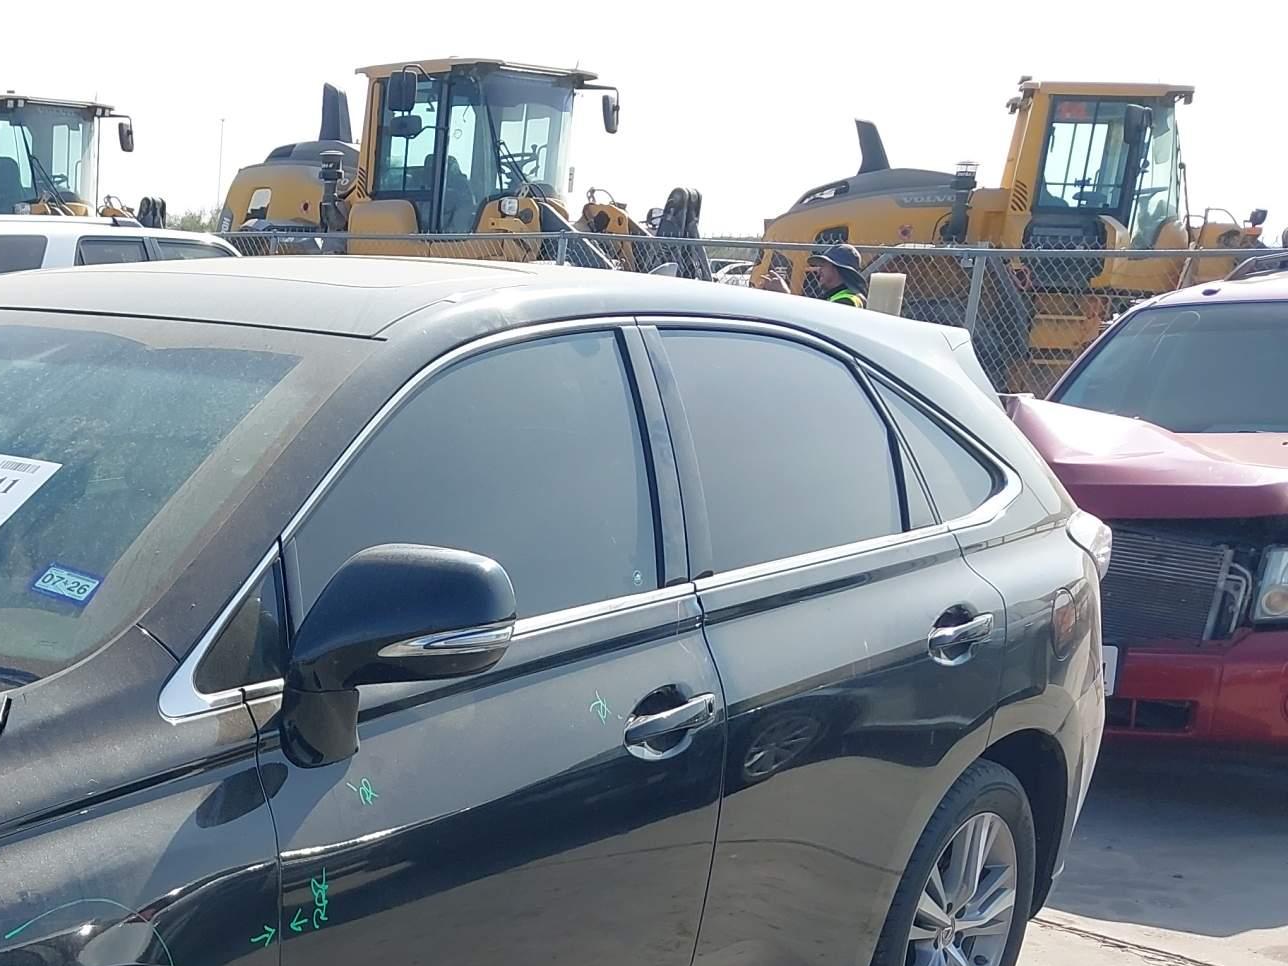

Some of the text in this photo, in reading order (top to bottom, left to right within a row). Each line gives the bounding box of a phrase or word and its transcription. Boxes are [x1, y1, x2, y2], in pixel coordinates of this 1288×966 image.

[902, 194, 957, 204] VOLVO
[41, 572, 91, 595] 07 26
